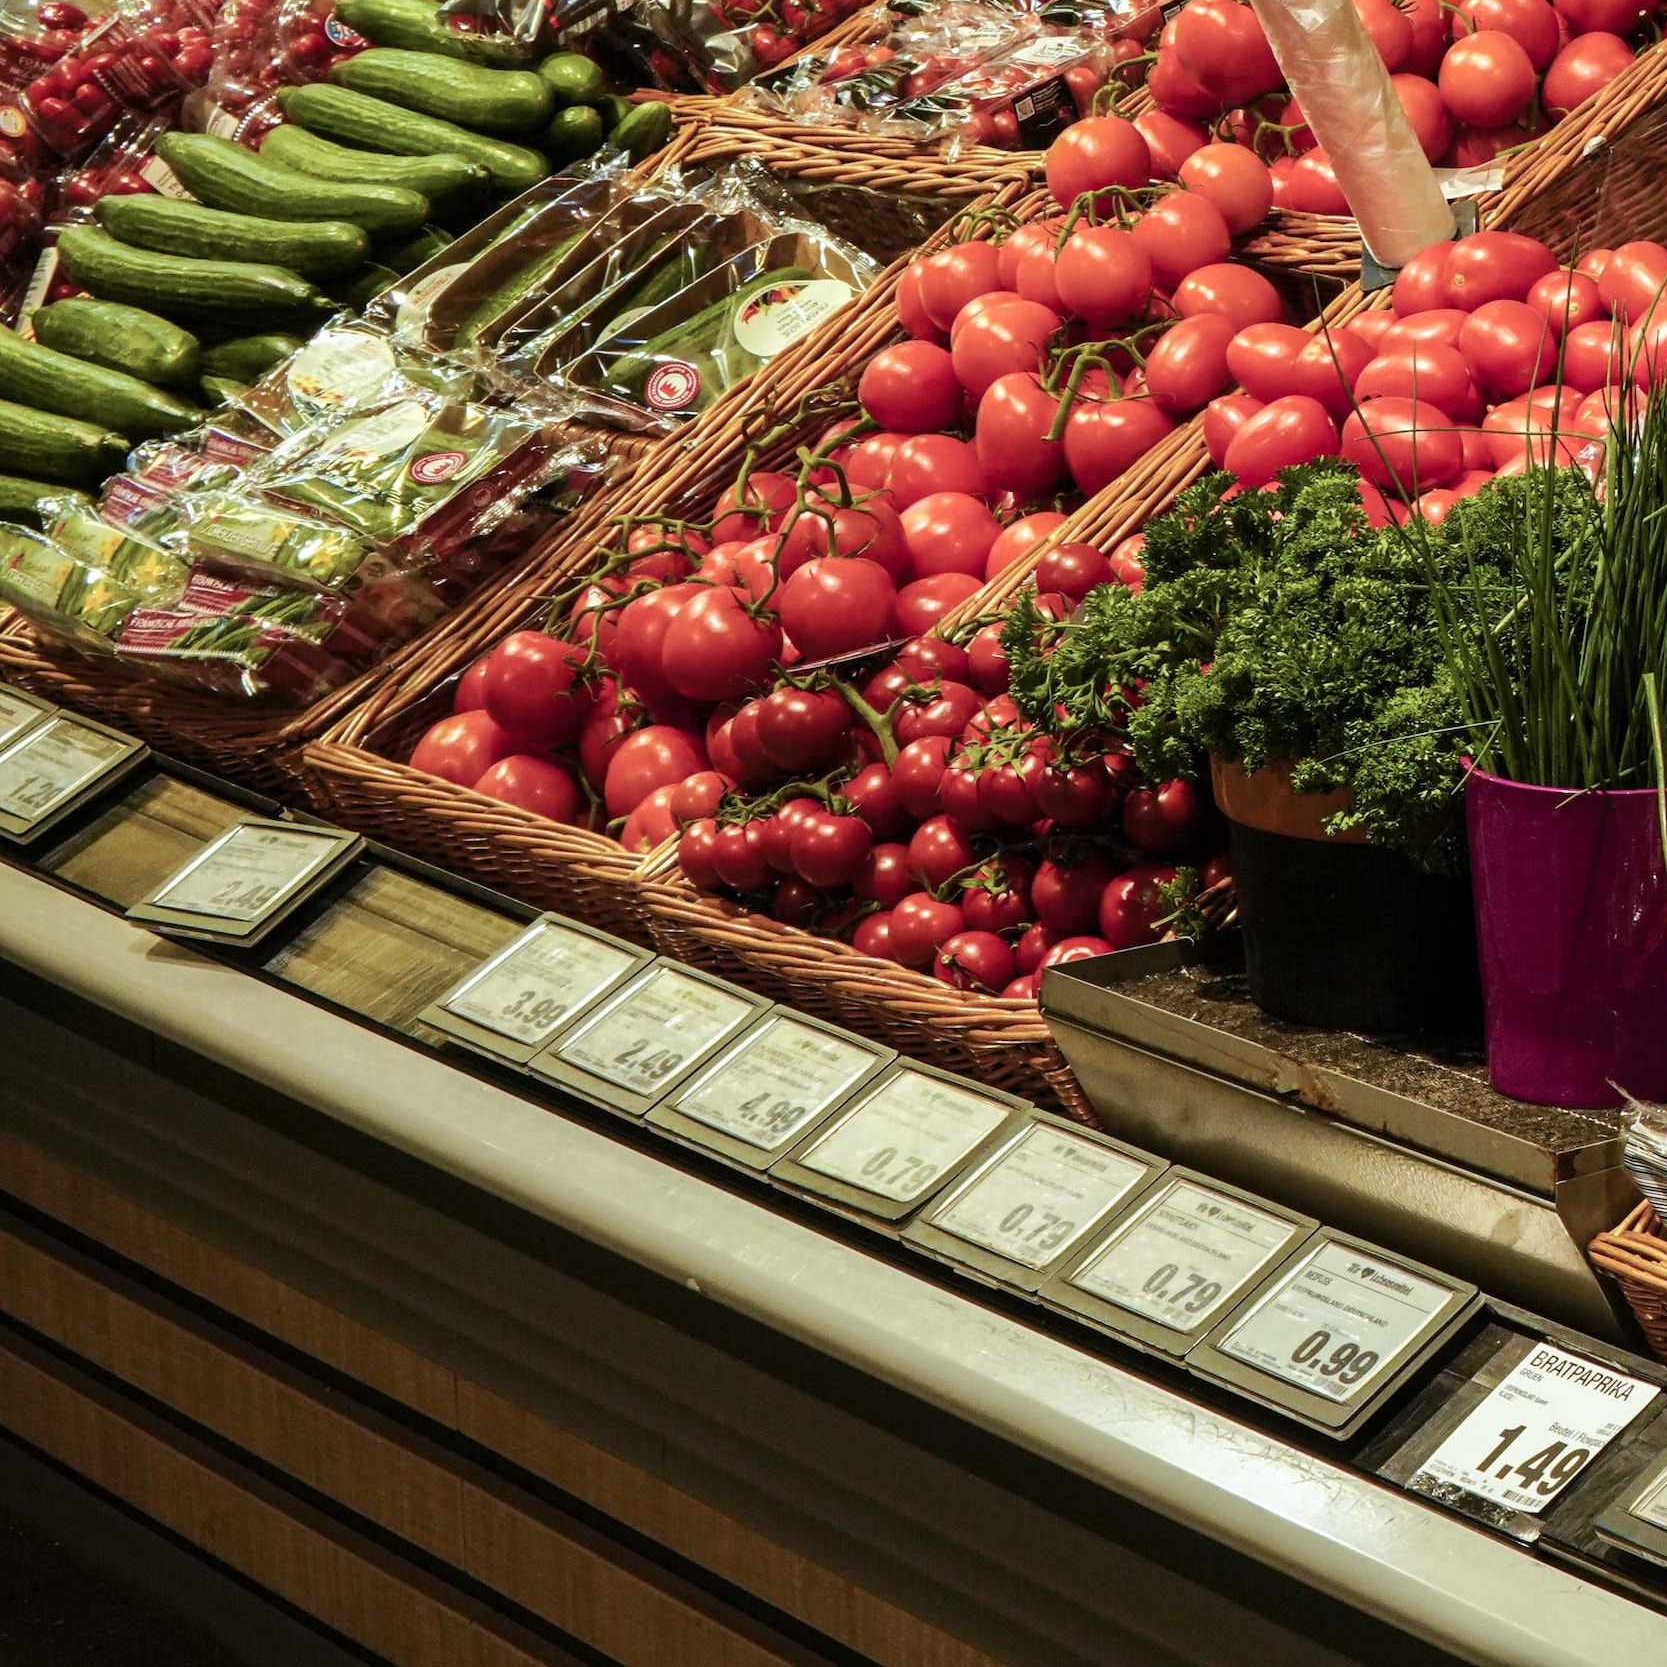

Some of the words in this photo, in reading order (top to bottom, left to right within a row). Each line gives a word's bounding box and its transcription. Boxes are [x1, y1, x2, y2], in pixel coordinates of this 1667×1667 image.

[502, 989, 569, 1030] 3.99
[614, 1037, 684, 1080] 2.49
[738, 1091, 806, 1134] 4.99
[860, 1146, 938, 1194] 0.79
[998, 1202, 1077, 1251] 0.79
[1142, 1263, 1222, 1313] 0.79
[1304, 1270, 1333, 1286] BEIFUSS
[1291, 1330, 1379, 1385] 0.99
[1519, 1368, 1545, 1383] GRUEN
[1530, 1350, 1636, 1402] BRATPAPRIKA
[1549, 1422, 1575, 1437] Beutel
[1475, 1424, 1591, 1497] 1.49
